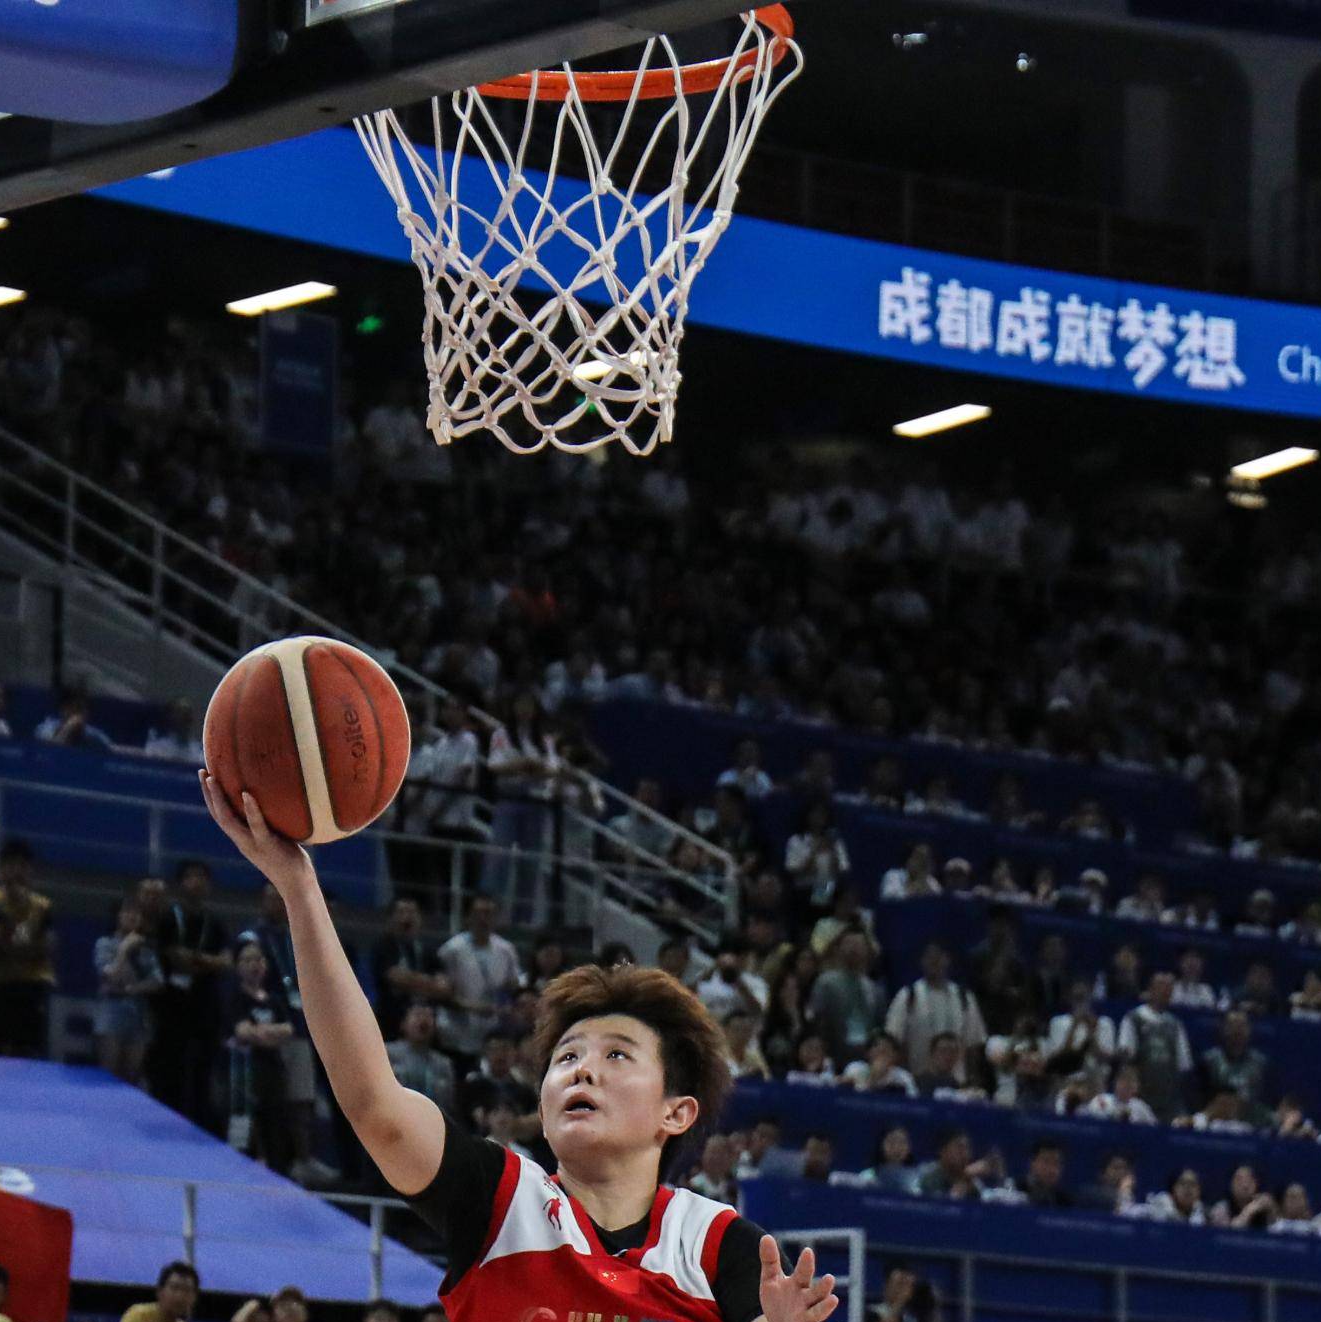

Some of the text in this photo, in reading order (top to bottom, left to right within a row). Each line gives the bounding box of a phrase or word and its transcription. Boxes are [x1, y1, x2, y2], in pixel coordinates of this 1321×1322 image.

[878, 266, 1247, 391] 成都成就梦想
